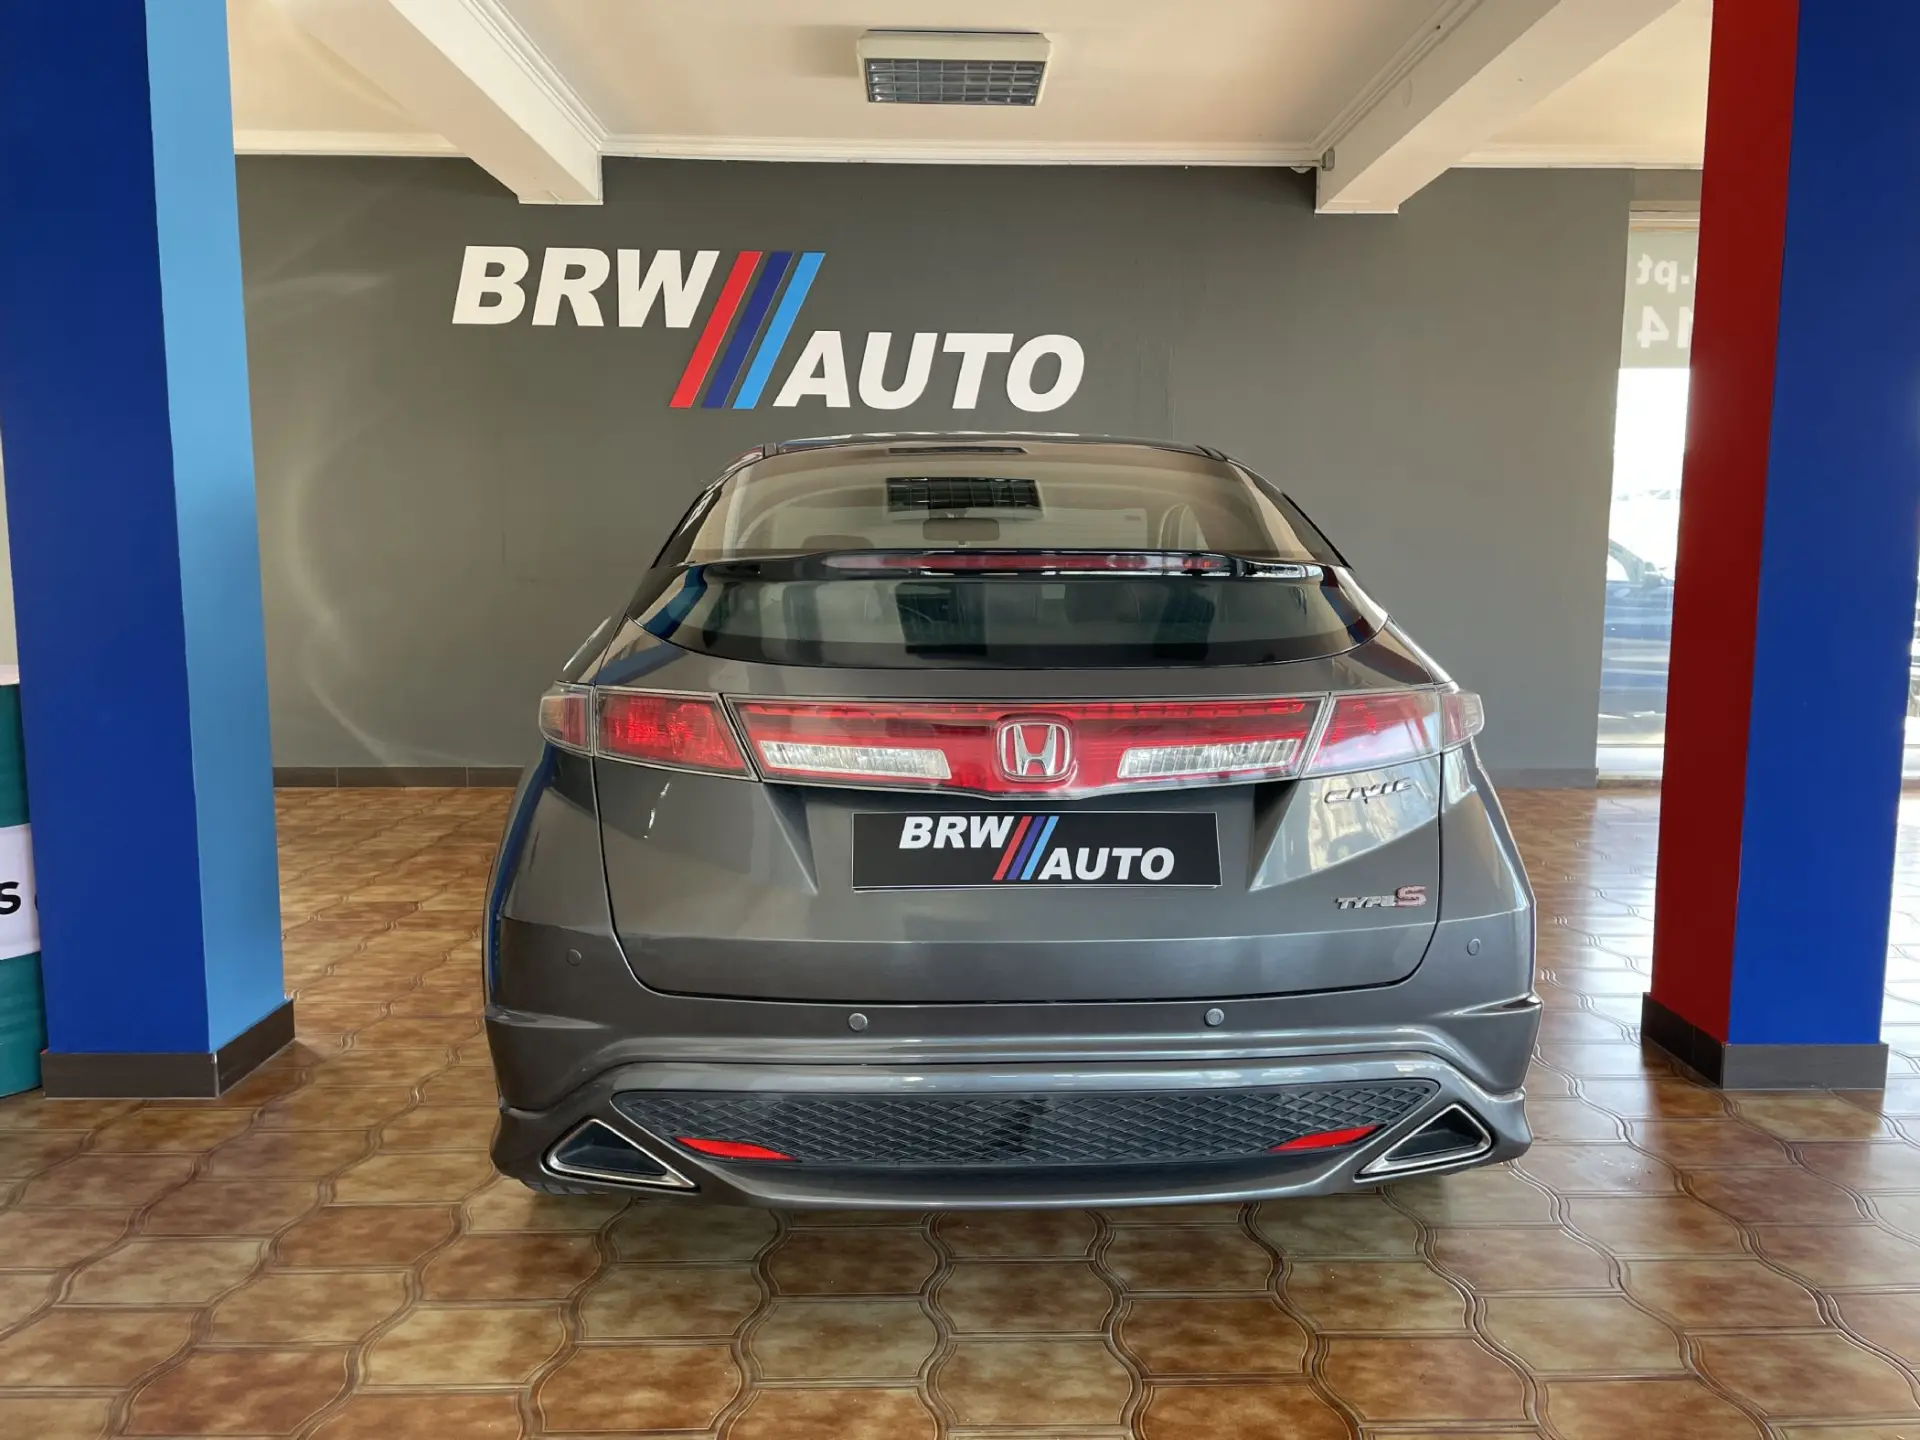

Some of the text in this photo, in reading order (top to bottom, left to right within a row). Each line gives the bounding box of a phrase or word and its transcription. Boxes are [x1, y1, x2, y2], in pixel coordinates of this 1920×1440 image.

[452, 245, 720, 328] BRW
[772, 330, 1085, 412] AUTO
[1324, 777, 1413, 804] CIVIC
[898, 815, 1015, 849] BRW
[1037, 847, 1175, 881] AUTO
